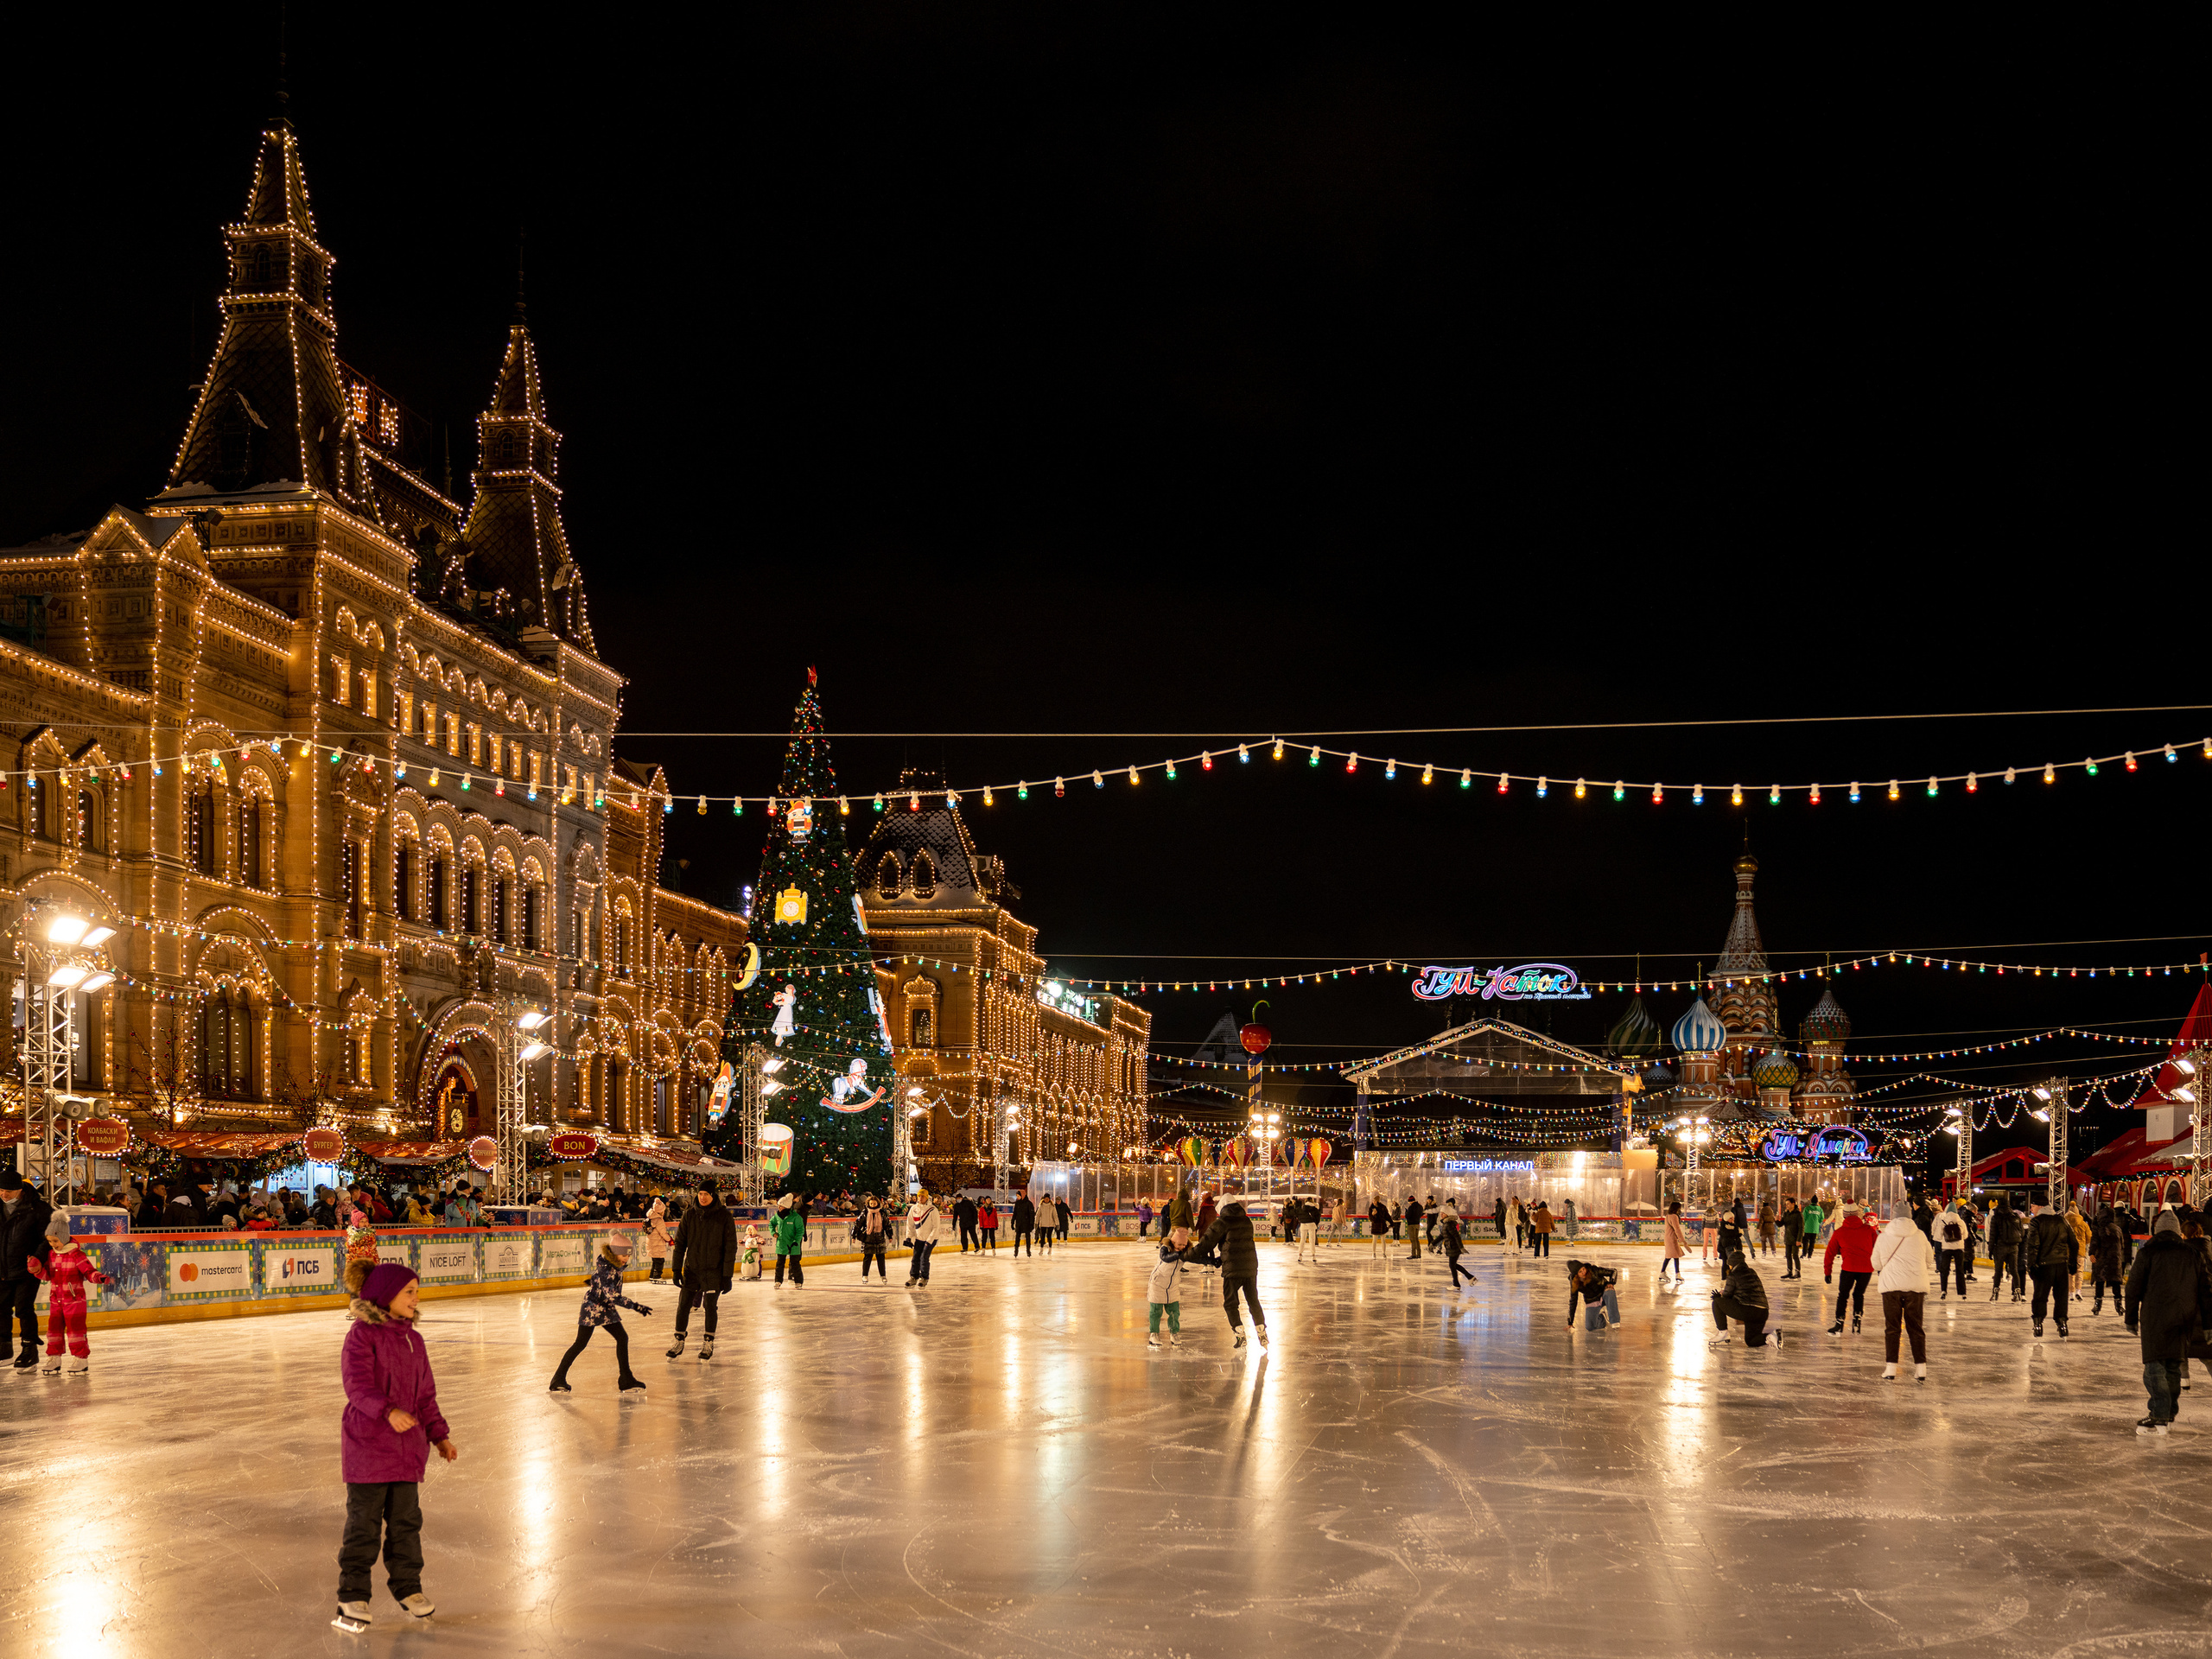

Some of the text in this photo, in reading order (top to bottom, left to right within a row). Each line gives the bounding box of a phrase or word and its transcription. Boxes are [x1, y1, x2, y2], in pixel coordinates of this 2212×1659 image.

[313, 1141, 334, 1149] БУРГЕР
[563, 1141, 586, 1150] BON
[1444, 1159, 1535, 1171] ПЕРВЫЙ КАНАЛ
[448, 1255, 467, 1267] LOFT
[200, 1264, 243, 1275] mastercard
[297, 1260, 320, 1274] ПСБ
